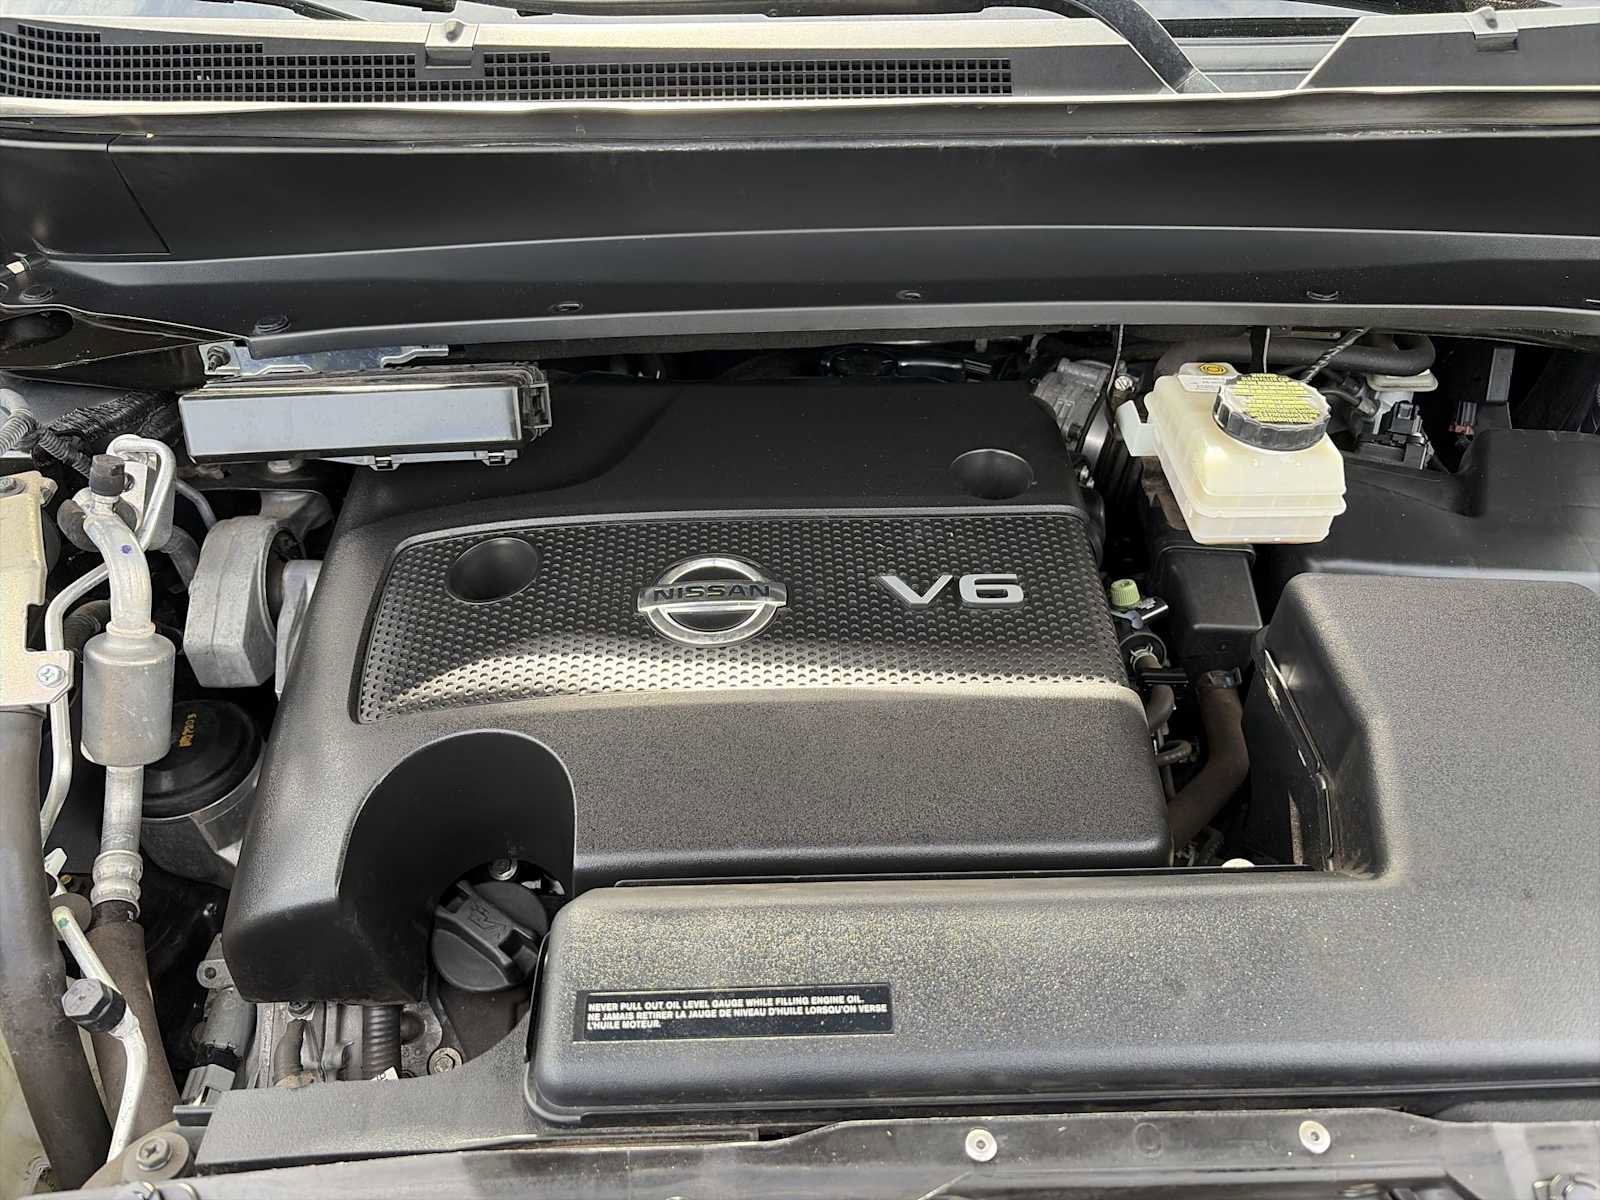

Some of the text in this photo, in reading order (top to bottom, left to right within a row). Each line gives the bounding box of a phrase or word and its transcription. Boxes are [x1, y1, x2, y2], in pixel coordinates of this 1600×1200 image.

[653, 583, 771, 602] NISSAN
[879, 573, 1025, 609] V6
[588, 995, 865, 1012] NEVER PULL OUT OIL LEVEL GAUGE WHILE FILLING ENGINE OIL.
[588, 1004, 887, 1021] NE JAMAIS RETIRER LA JAUGE DE NIVEAU D'HUILE LORSQU'ON VERSE
[587, 1021, 620, 1030] L'HUILE
